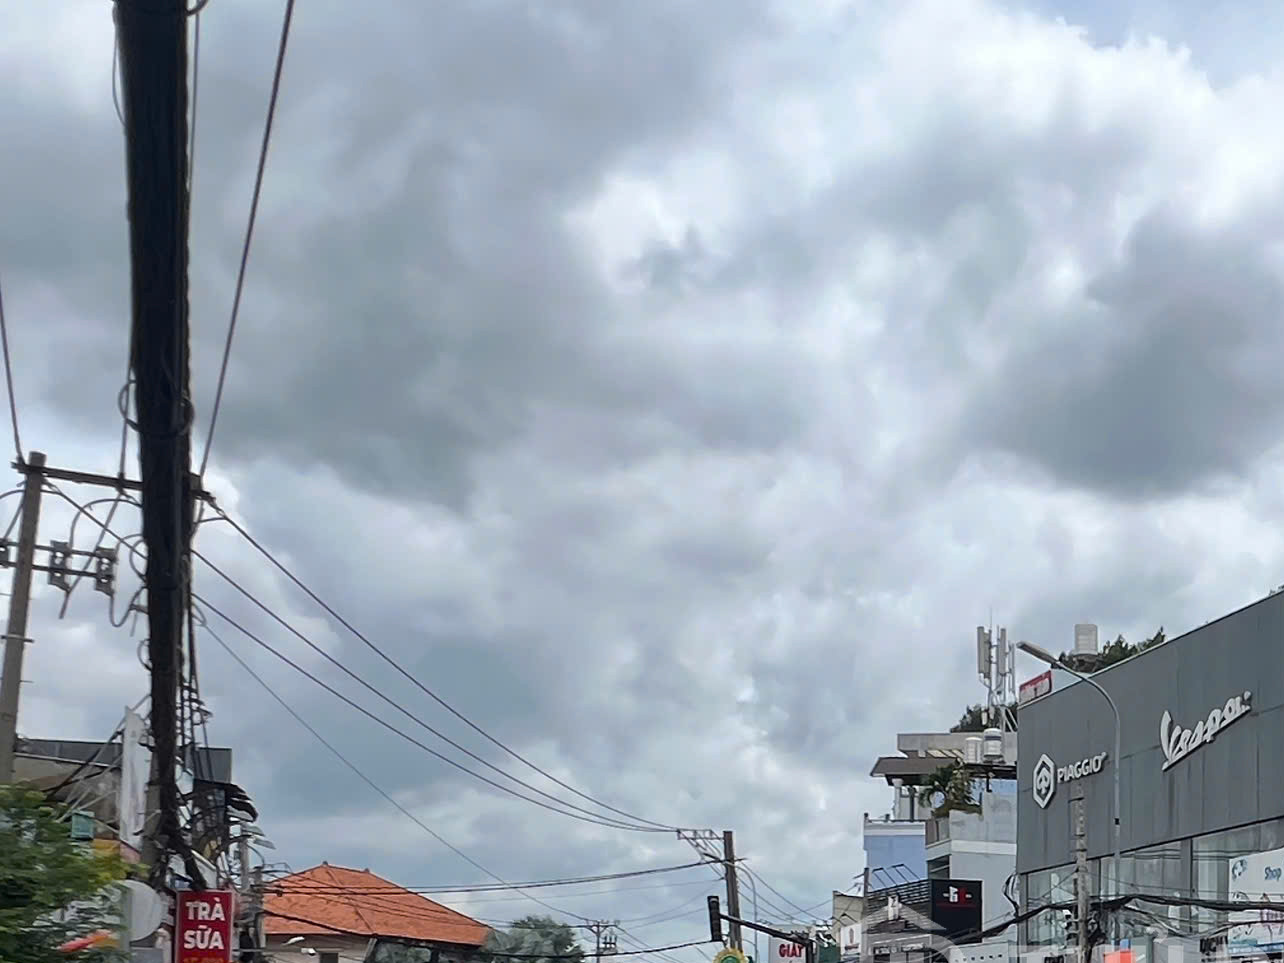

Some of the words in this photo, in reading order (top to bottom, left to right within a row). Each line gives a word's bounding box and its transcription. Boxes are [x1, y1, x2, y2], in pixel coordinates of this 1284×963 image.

[1161, 692, 1251, 772] Vespa
[1057, 755, 1105, 784] PIAGGIO
[1264, 866, 1282, 882] Shop
[185, 897, 226, 921] TRÀ
[184, 925, 225, 949] SỮA
